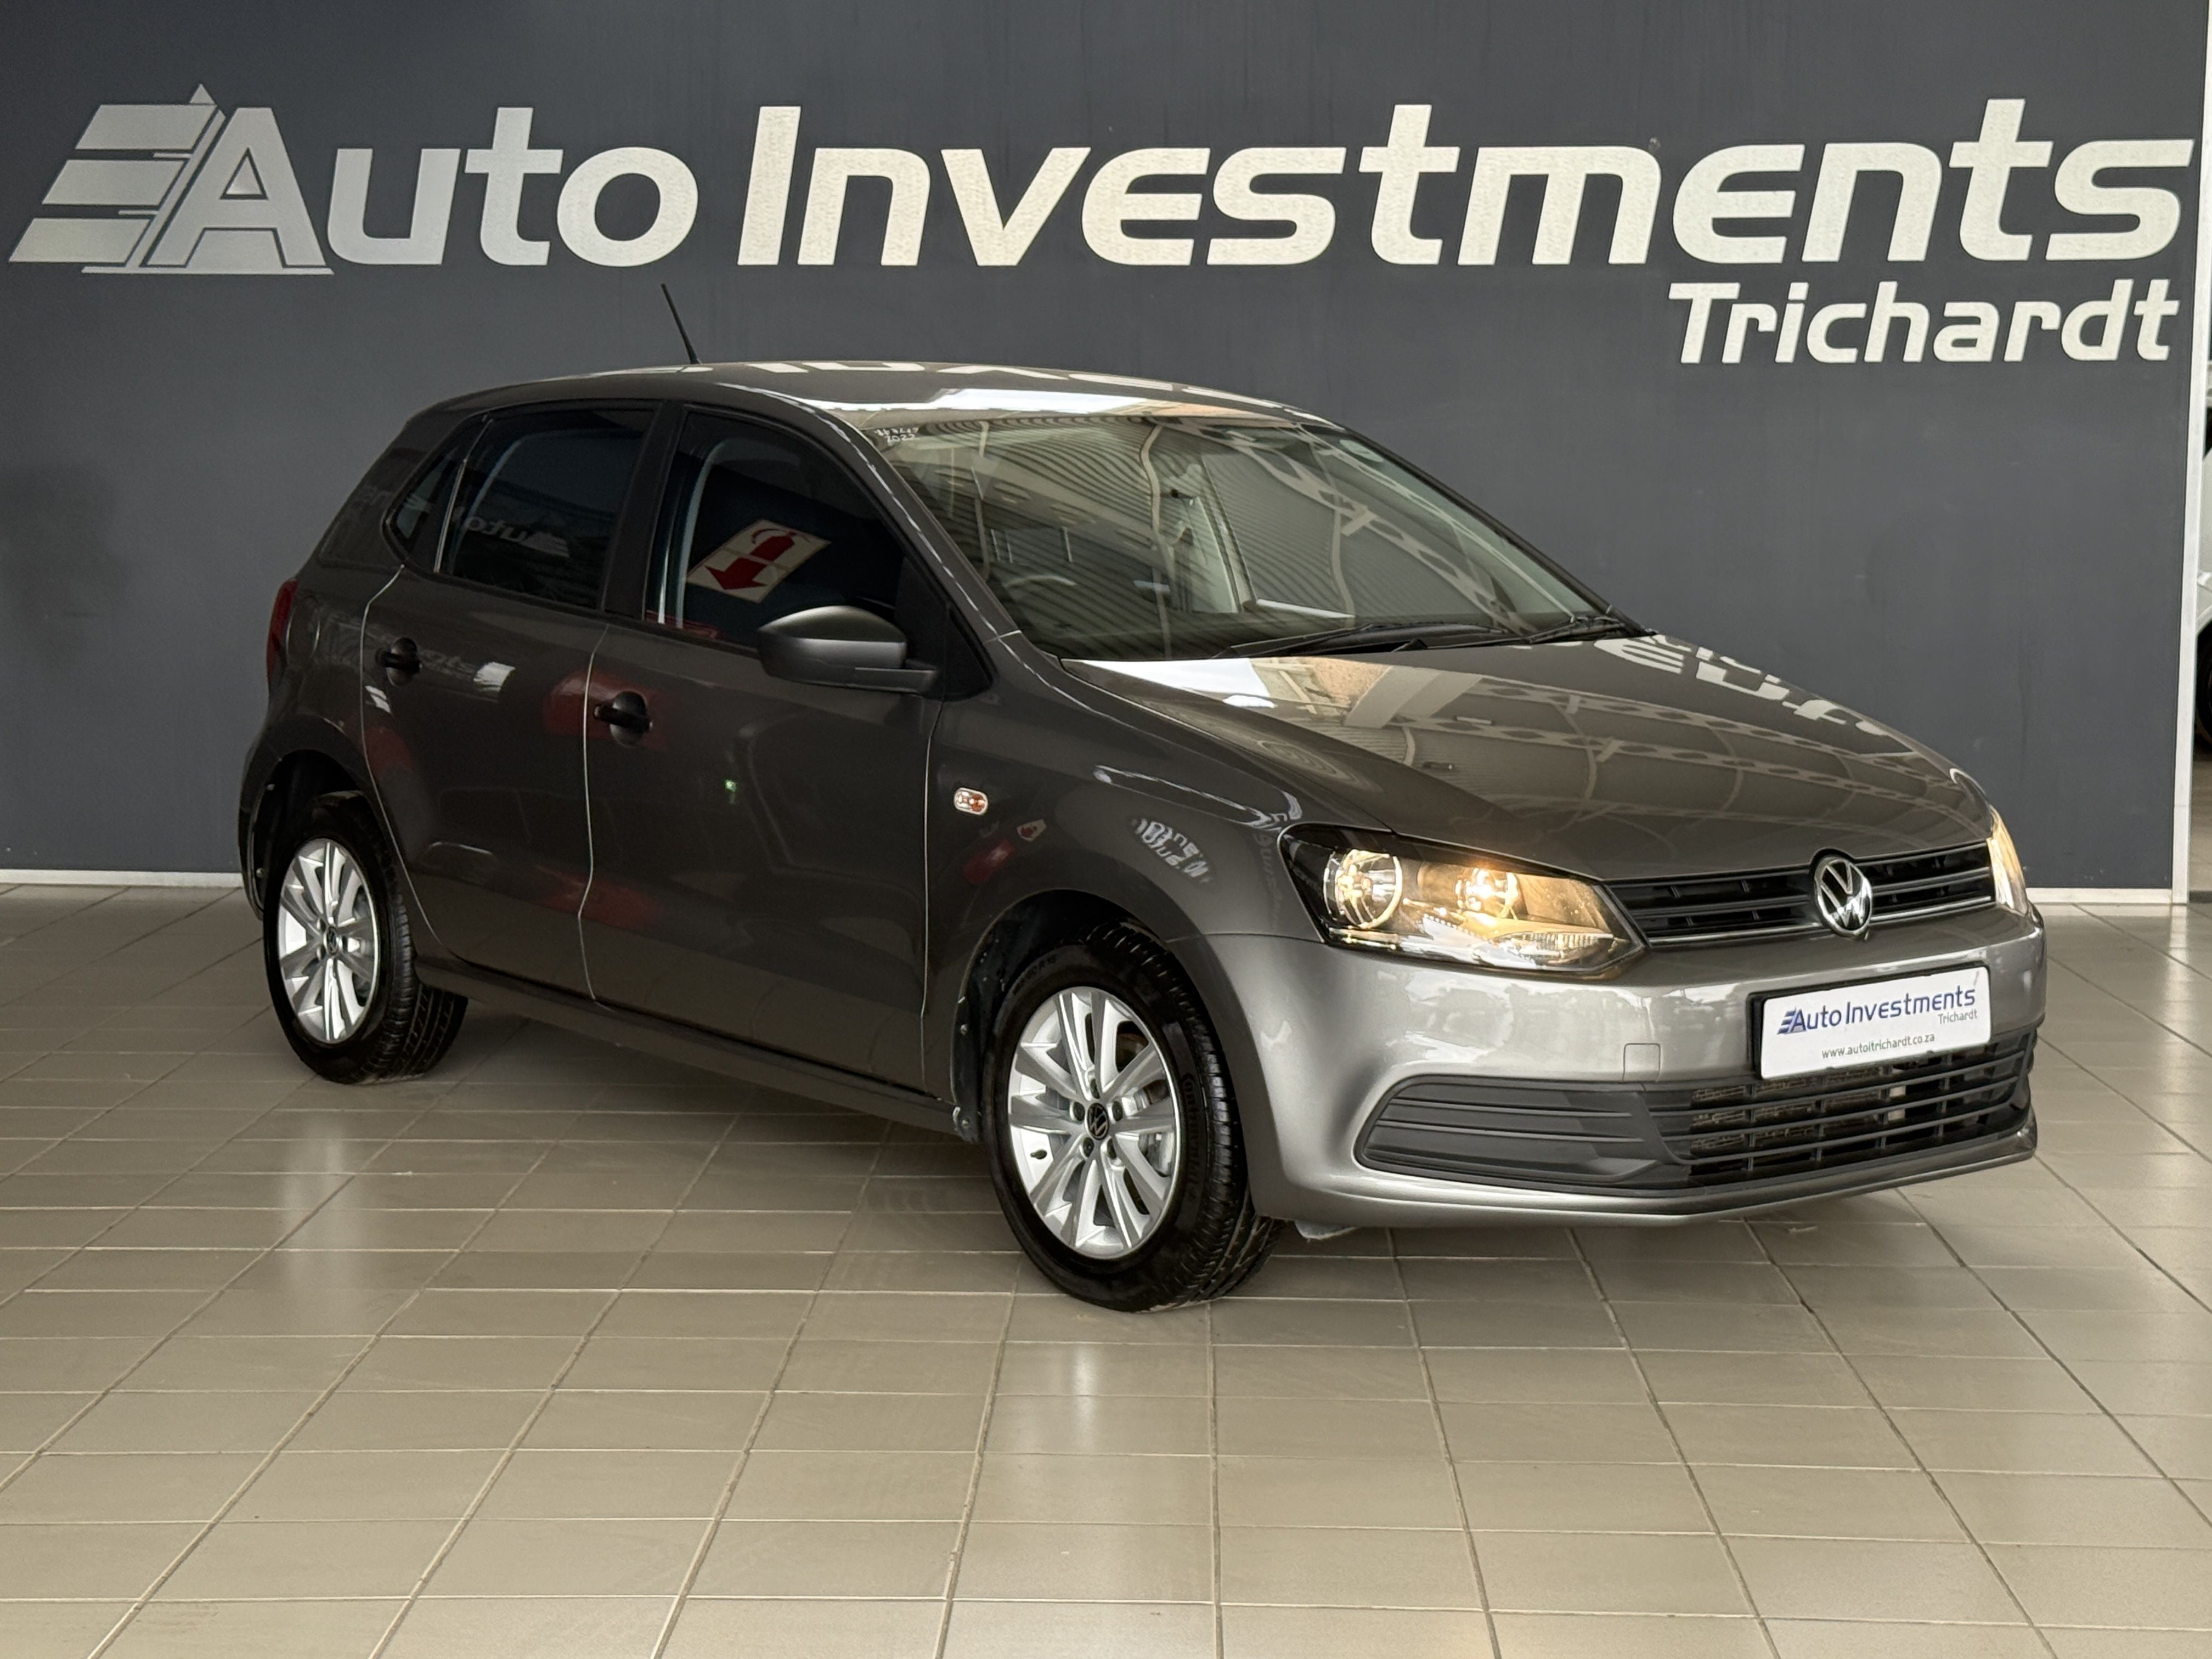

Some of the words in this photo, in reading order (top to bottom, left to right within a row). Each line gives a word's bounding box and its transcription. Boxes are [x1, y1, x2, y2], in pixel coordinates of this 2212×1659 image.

[146, 106, 698, 267] Auto
[737, 99, 2194, 267] Investments
[1669, 279, 2181, 364] Trichardt
[1790, 1005, 1842, 1032] Auto
[1846, 985, 1976, 1025] Investments
[1938, 1008, 1978, 1025] Trichardt
